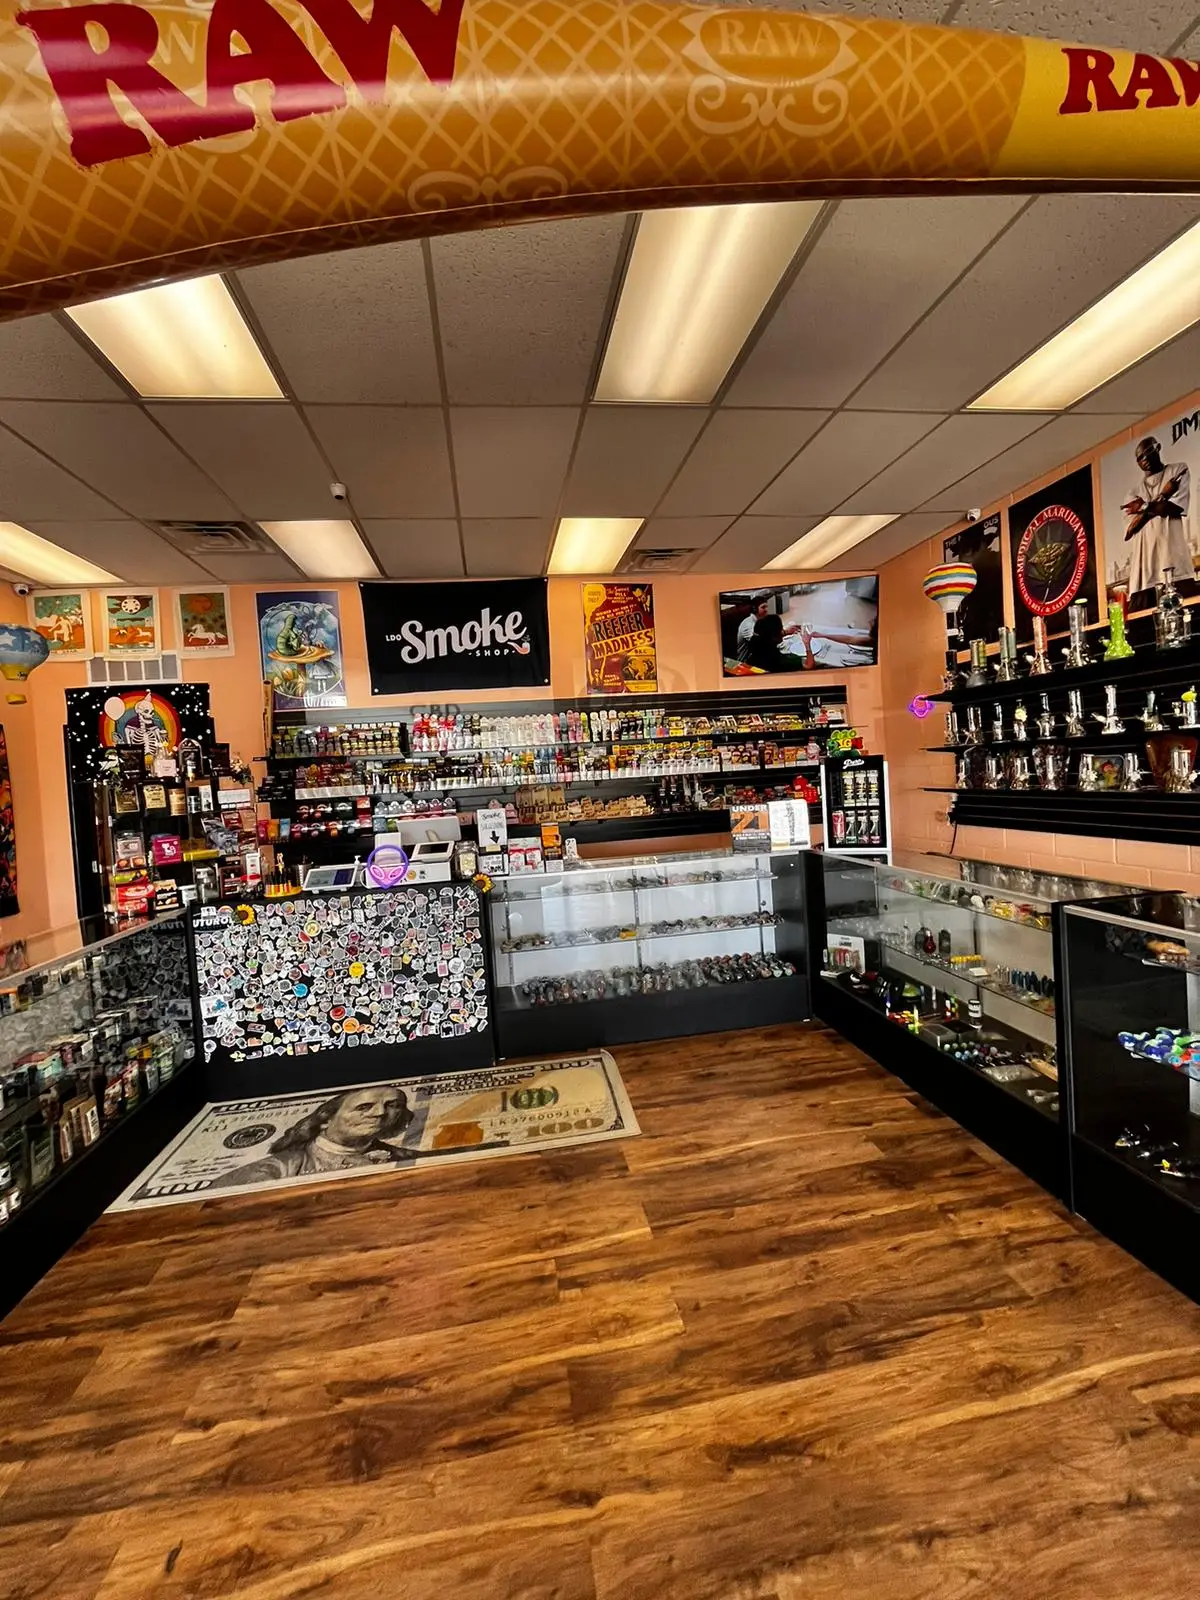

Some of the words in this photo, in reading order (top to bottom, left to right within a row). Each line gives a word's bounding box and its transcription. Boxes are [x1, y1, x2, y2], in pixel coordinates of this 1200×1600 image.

[717, 19, 822, 57] RAW
[15, 0, 466, 169] RAW
[1017, 518, 1041, 574] MEDICAL
[1042, 507, 1087, 547] MARIJUANA
[385, 634, 401, 642] LDO
[401, 607, 527, 664] Smoke
[592, 611, 646, 641] REEFER
[475, 649, 510, 657] SHOP
[593, 630, 653, 658] MADNESS
[410, 704, 461, 717] CBD
[732, 804, 768, 812] UNDER
[731, 811, 769, 834] 21
[147, 1180, 213, 1197] 100
